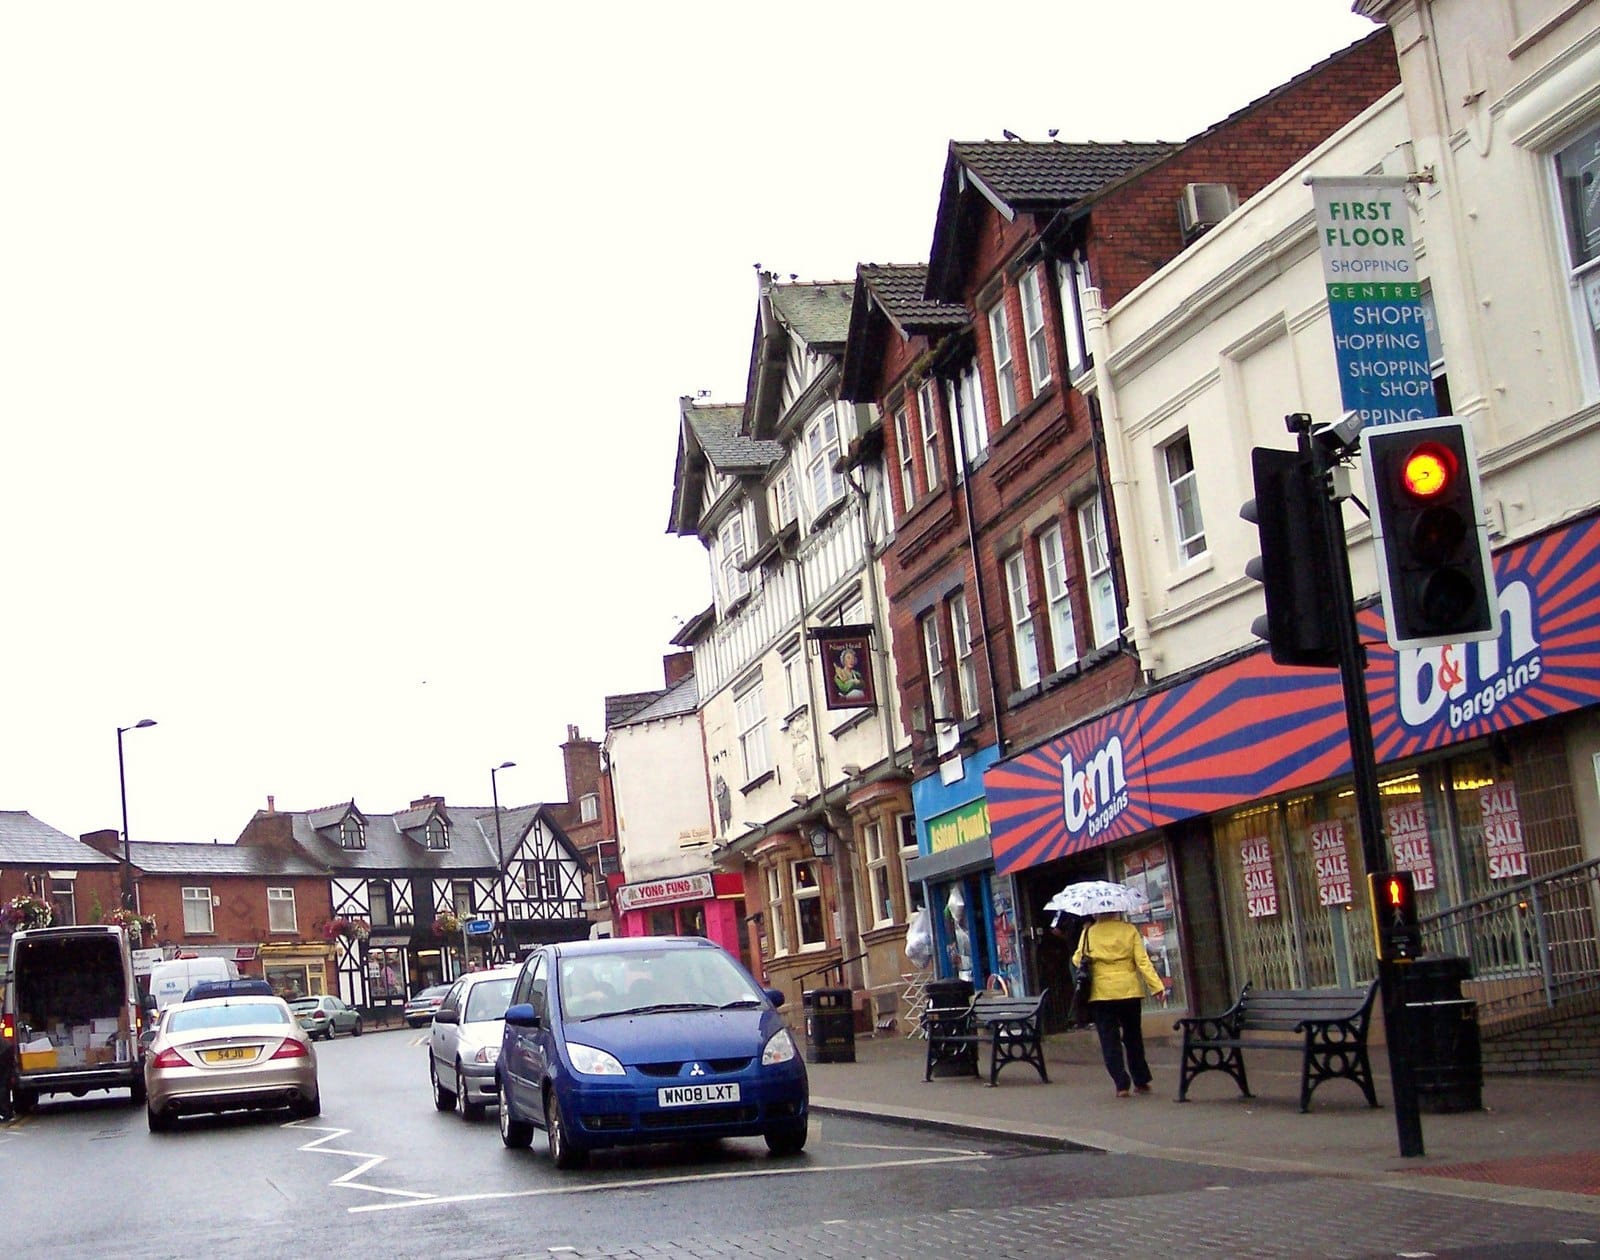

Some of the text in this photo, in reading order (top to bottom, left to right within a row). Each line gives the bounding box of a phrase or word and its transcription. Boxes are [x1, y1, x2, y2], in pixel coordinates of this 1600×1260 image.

[1329, 202, 1393, 221] FIRST
[1326, 227, 1406, 247] FLOOR
[1331, 259, 1409, 273] SHOPPING
[1330, 287, 1418, 299] CENTRE
[1353, 306, 1424, 325] SHOPP
[1336, 333, 1420, 350] HOPPING
[1349, 360, 1430, 377] SHOPPIN
[1450, 656, 1541, 729] bargains
[1061, 736, 1127, 833] b&m
[1089, 791, 1128, 837] bargains
[1390, 809, 1425, 835] SALE
[1312, 827, 1344, 850] SALE
[1241, 844, 1270, 865] SALE
[1394, 838, 1430, 864] SALE
[1316, 855, 1349, 878] SALE
[638, 884, 664, 899] YONG
[665, 880, 691, 894] FUNG
[1245, 870, 1274, 891] SALE
[1320, 882, 1352, 906] SALE
[1248, 896, 1276, 917] SALE
[664, 1085, 733, 1103] WN08 LXT
